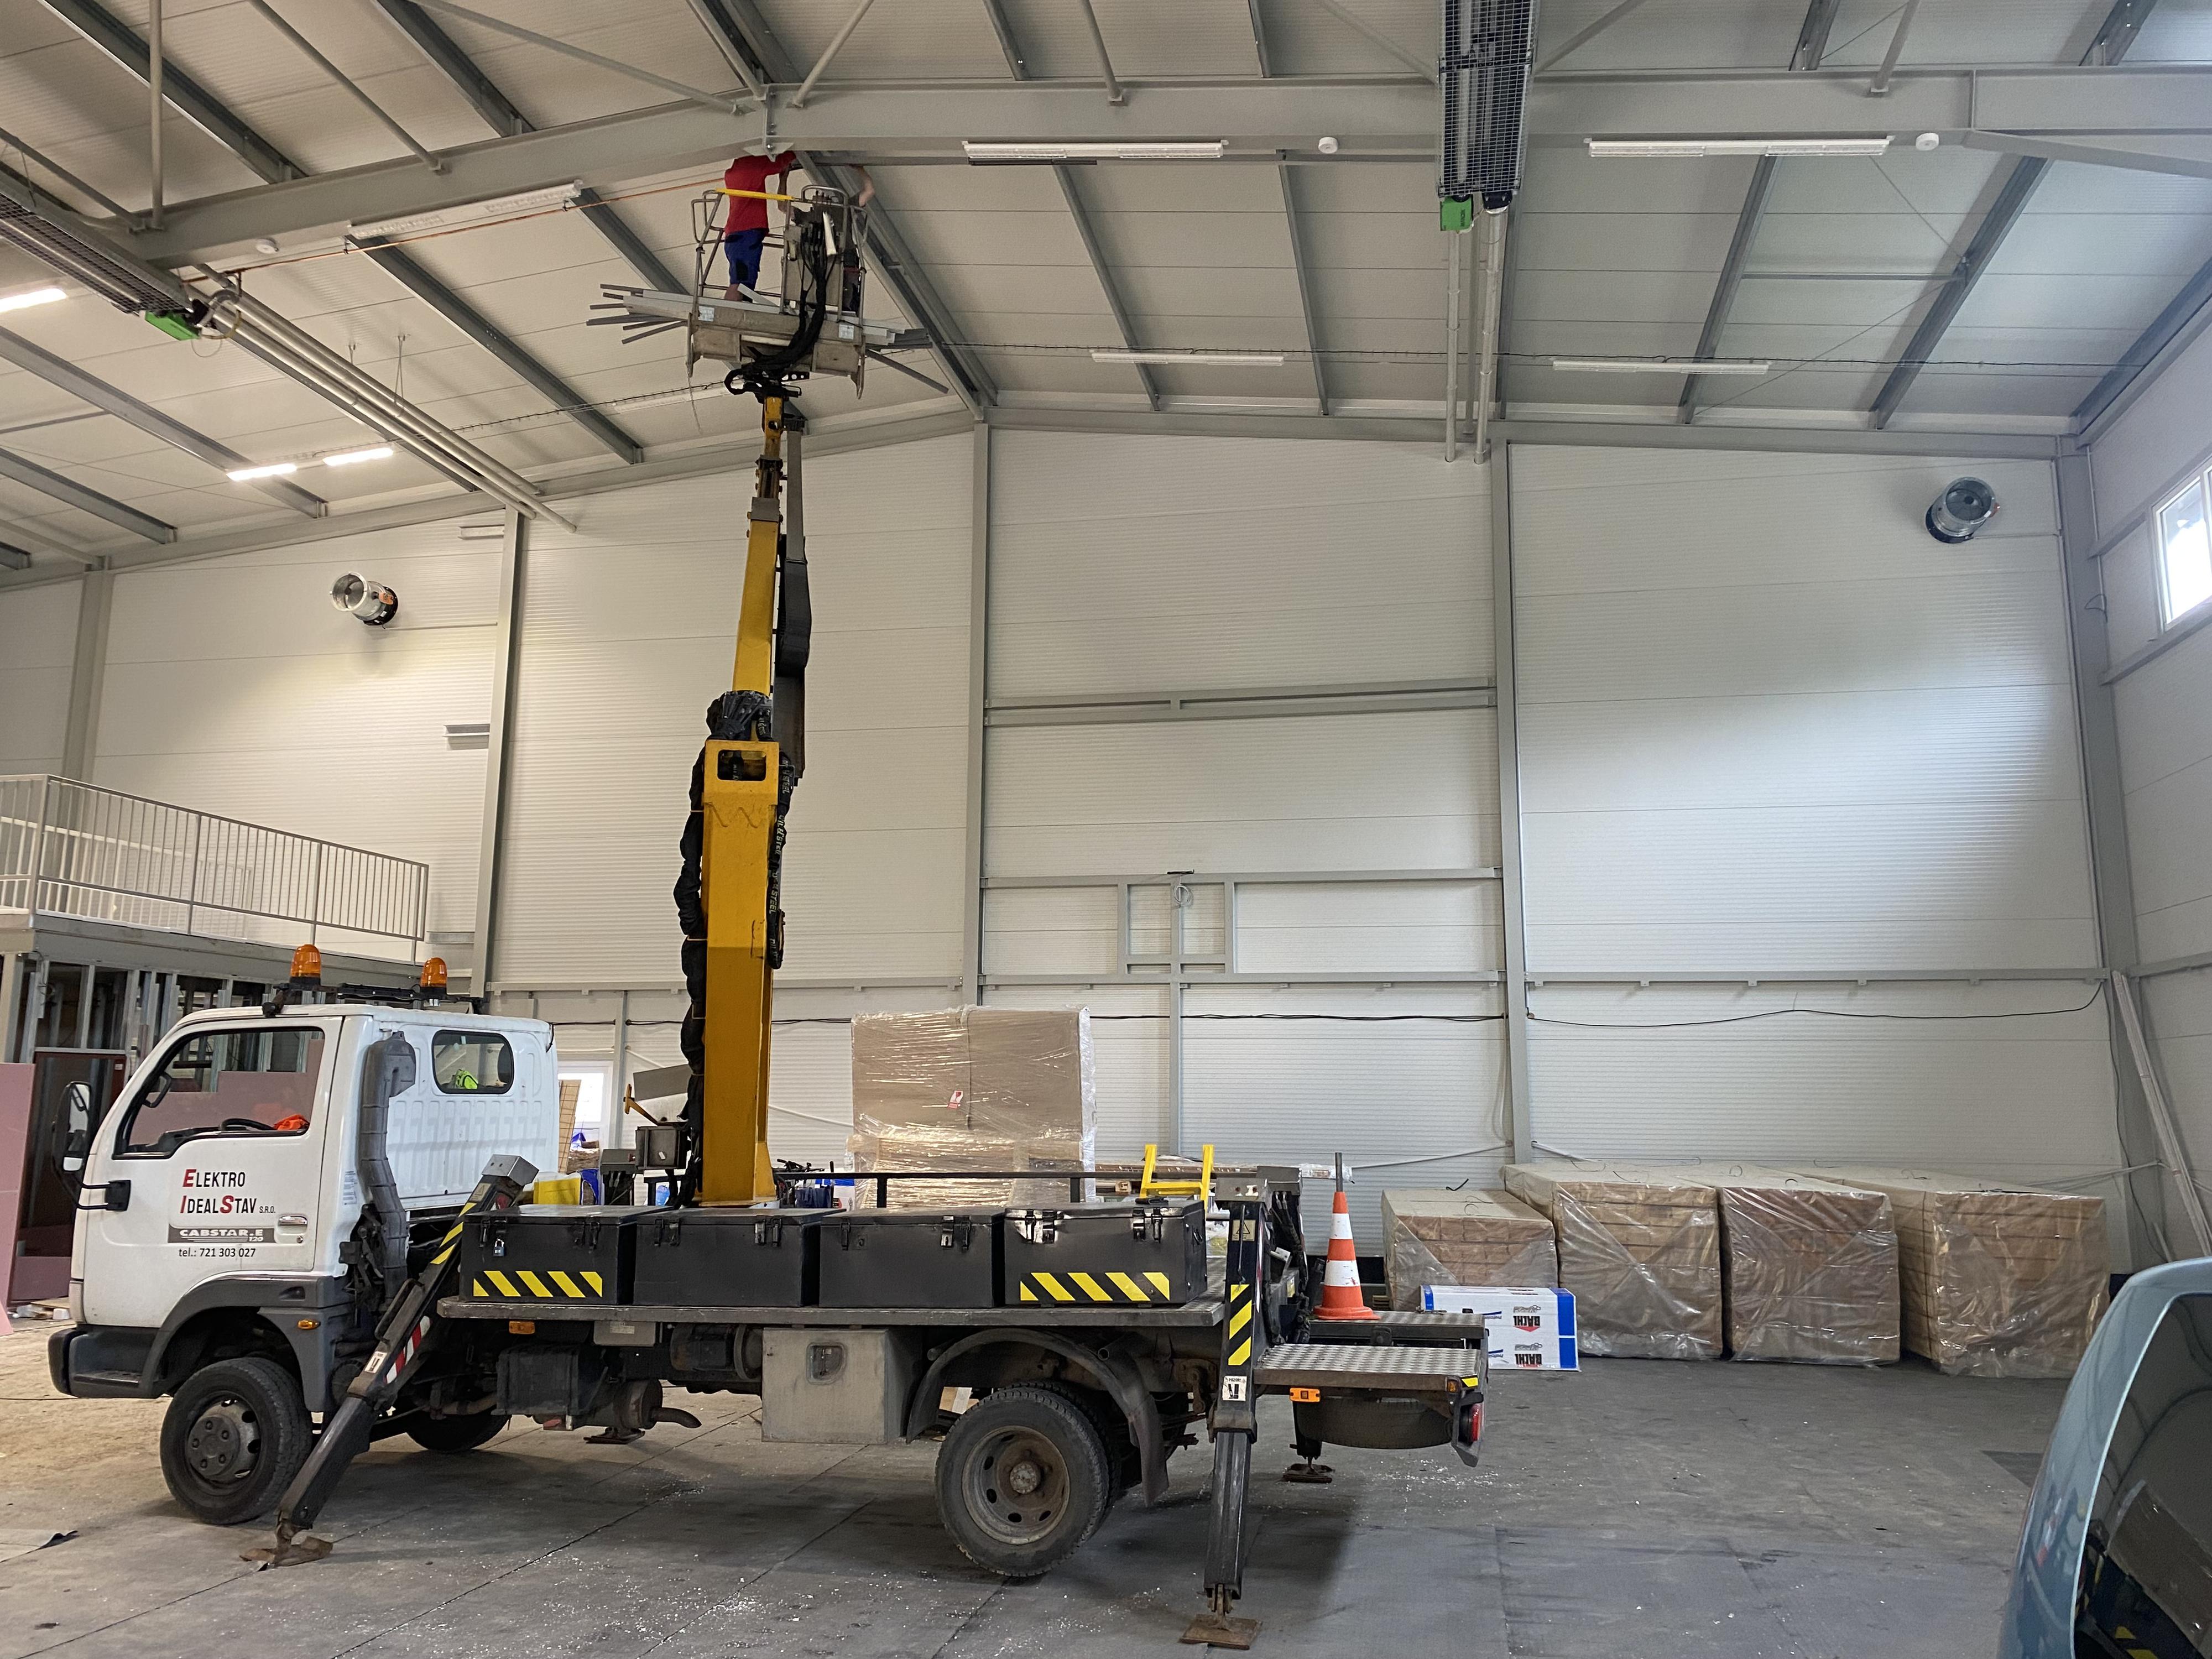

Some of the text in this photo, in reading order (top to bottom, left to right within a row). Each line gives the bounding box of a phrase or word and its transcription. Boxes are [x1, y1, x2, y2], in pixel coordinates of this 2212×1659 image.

[769, 890, 778, 914] STEEL
[182, 1169, 246, 1187] ELEKTRO
[180, 1195, 257, 1214] IDEALSTAV
[179, 1248, 256, 1257] tel.: 721 303 027
